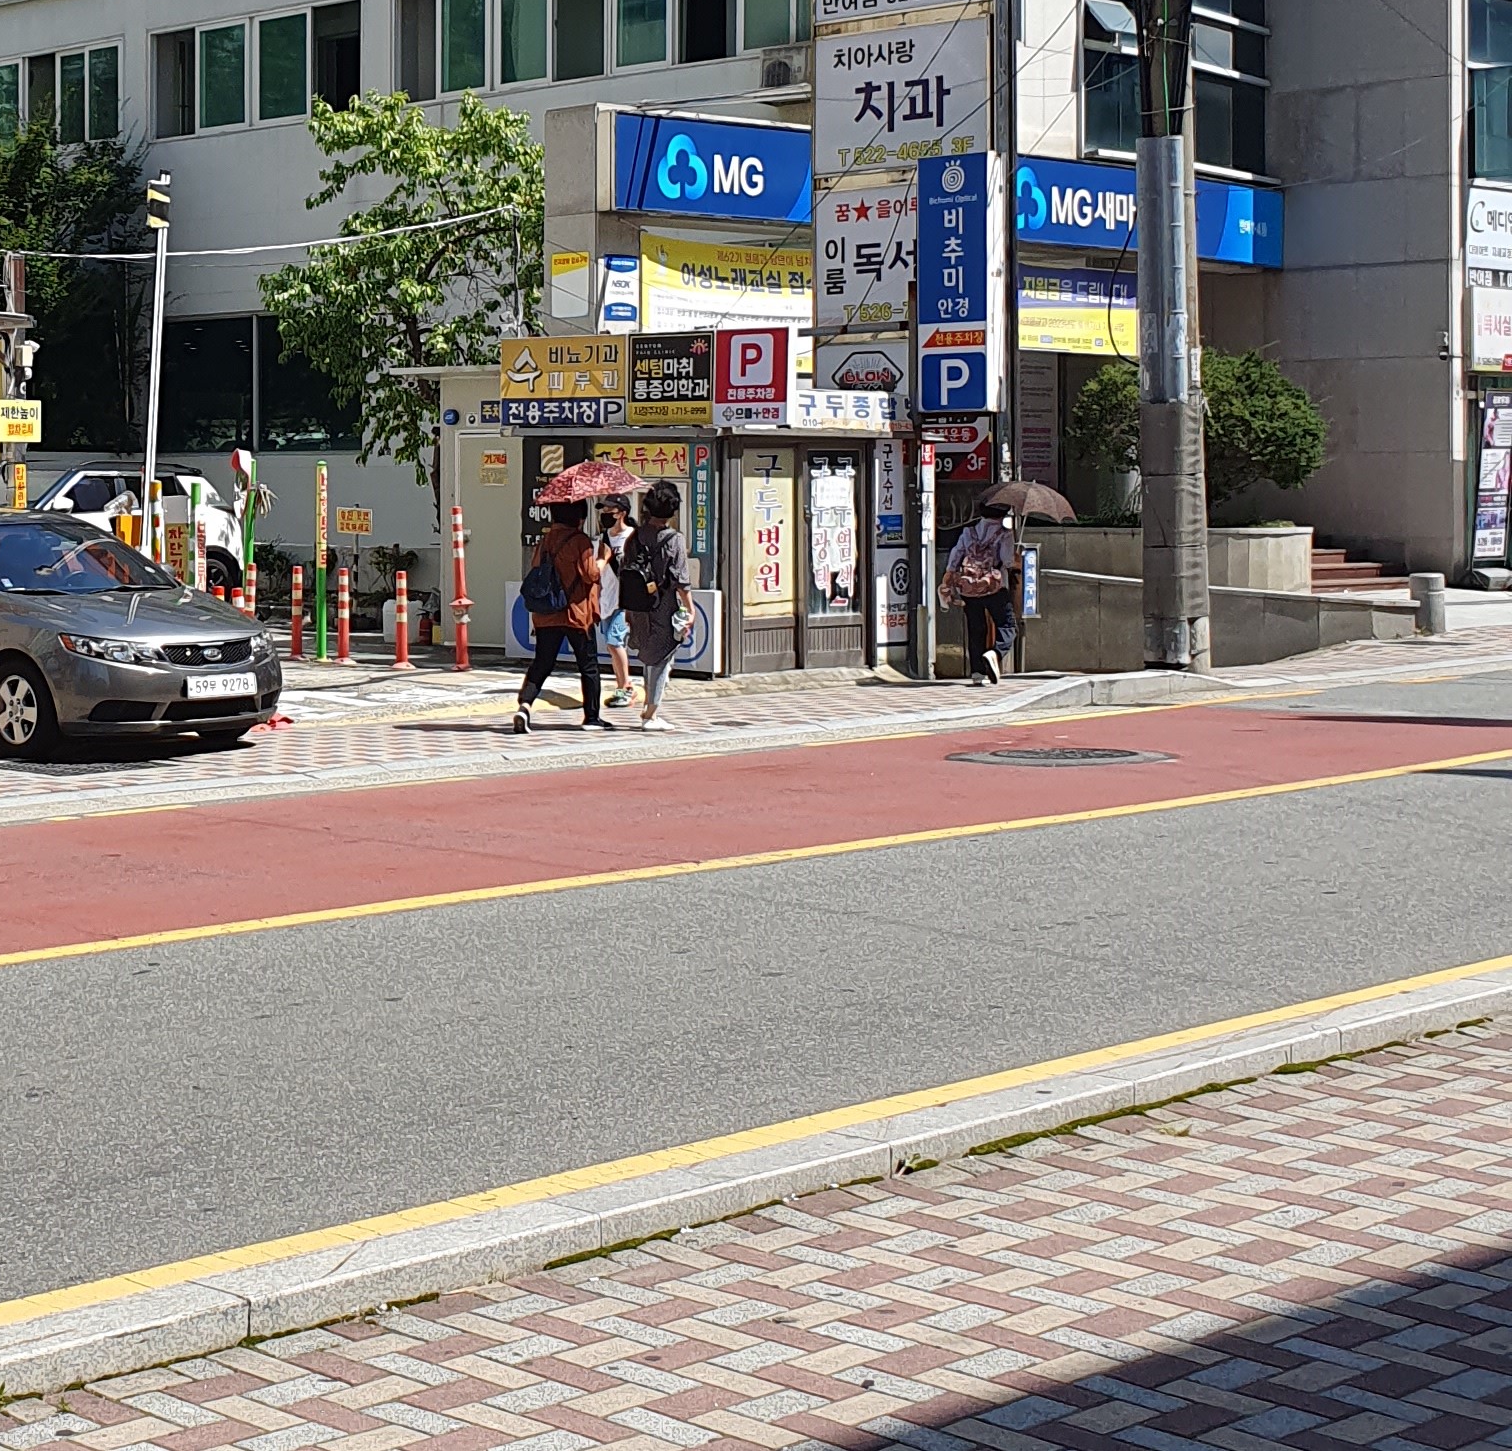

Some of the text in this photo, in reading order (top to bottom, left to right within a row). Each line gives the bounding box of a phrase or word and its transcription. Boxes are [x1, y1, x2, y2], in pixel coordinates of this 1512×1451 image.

[833, 38, 916, 71] 치아사랑
[854, 75, 951, 133] 치과
[713, 153, 765, 197] MG
[941, 206, 965, 294] 비추미
[680, 262, 783, 294] 여성노래교실
[823, 236, 917, 296] 이룸 독서
[938, 297, 970, 319] 안경
[548, 345, 619, 365] 비뇨기과
[634, 357, 694, 378] 센텀마취
[740, 341, 763, 378] P
[633, 378, 710, 400] 통증의학과
[844, 370, 890, 384] GLOW
[940, 358, 970, 406] P
[0, 406, 39, 421] 제한높이
[508, 400, 598, 425] 전용주차장
[967, 452, 987, 471] 3F
[752, 452, 784, 596] 구두병원
[221, 677, 250, 692] 9278
